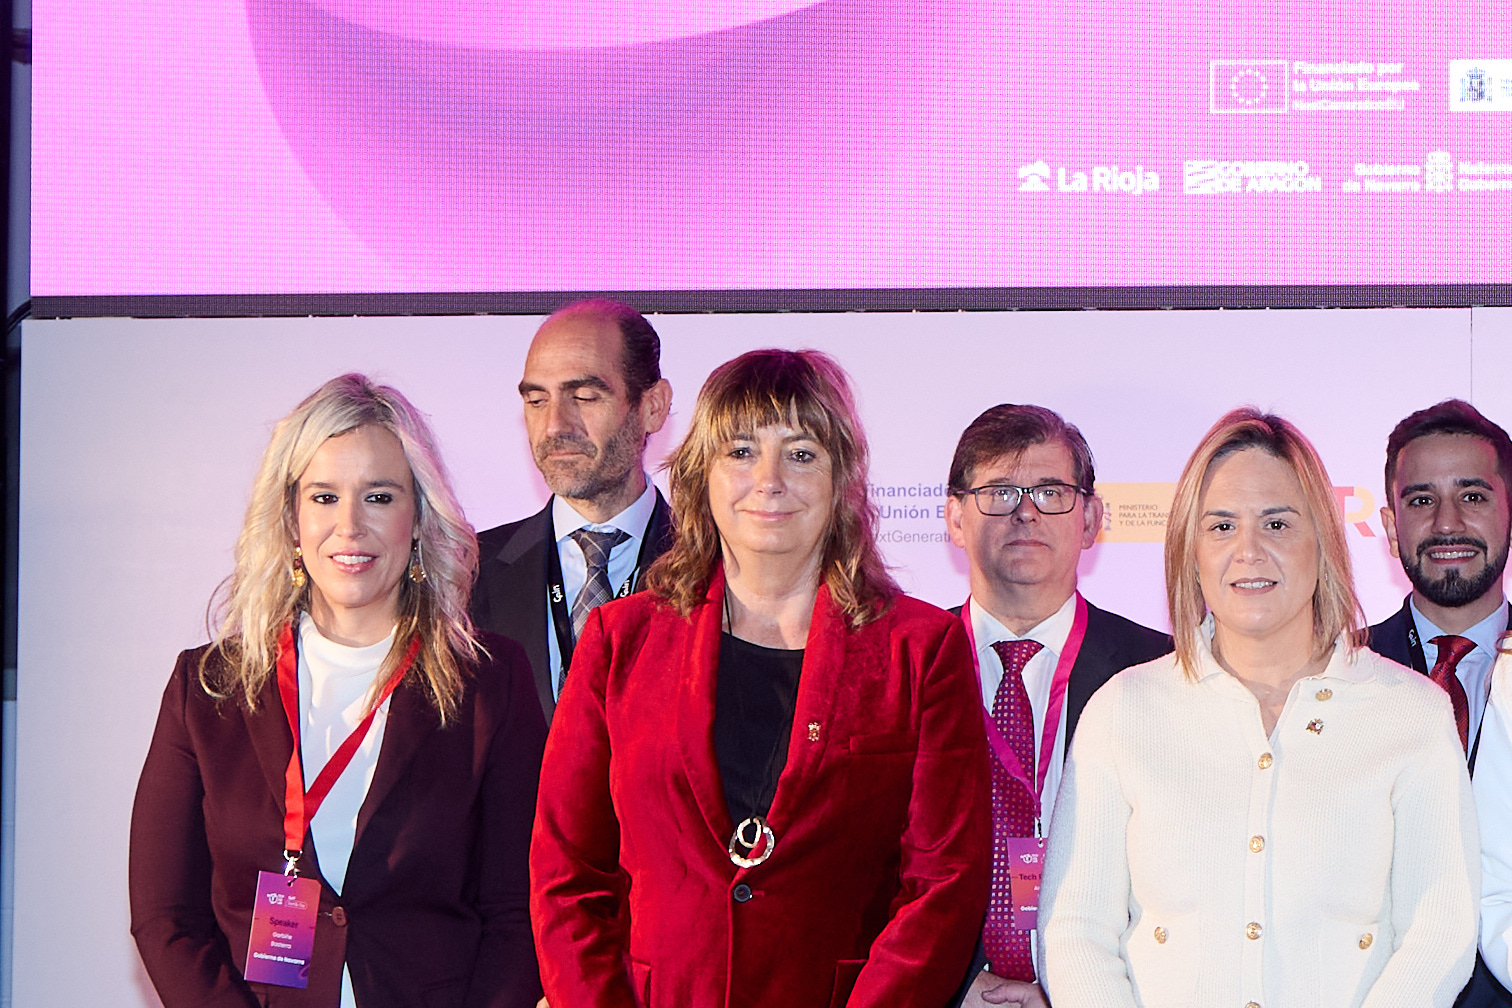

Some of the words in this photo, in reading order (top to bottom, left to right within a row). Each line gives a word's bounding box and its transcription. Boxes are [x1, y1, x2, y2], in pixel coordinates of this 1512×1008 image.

[1058, 167, 1087, 192] La
[1092, 165, 1159, 195] Rioja
[870, 483, 950, 498] inanciad
[880, 504, 930, 519] Unión
[1019, 873, 1036, 881] Tech
